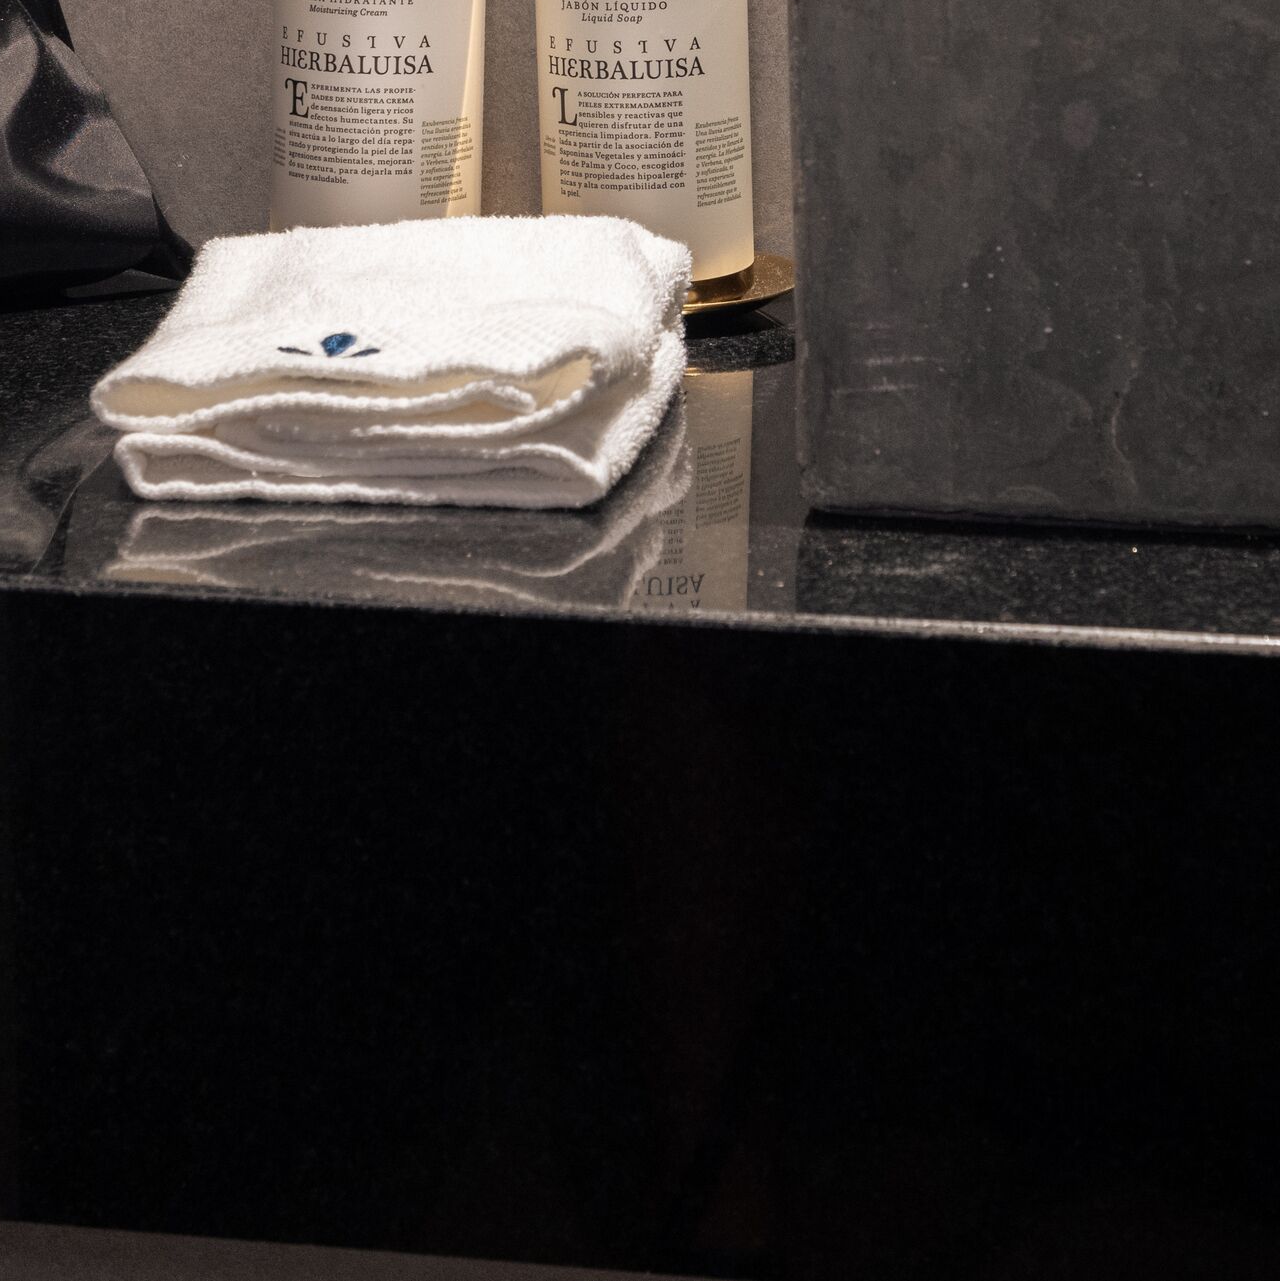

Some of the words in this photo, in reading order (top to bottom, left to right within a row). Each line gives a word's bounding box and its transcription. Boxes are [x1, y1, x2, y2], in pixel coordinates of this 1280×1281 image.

[309, 5, 358, 17] Moisturizing
[360, 8, 388, 17] Cream
[562, 0, 599, 10] JABÓN
[606, 1, 668, 12] LÍQUIDO
[581, 13, 613, 23] Liquid
[617, 14, 643, 23] Soap
[281, 45, 434, 75] HIERBALUISA
[549, 55, 705, 80] HIERBALUISA
[320, 105, 359, 113] sensación
[361, 107, 384, 115] ligera
[605, 101, 683, 109] EXTREMADAMENTE
[310, 113, 338, 122] efectos
[340, 116, 400, 124] humectantes.
[579, 111, 614, 119] sensibles
[625, 111, 665, 119] reactivas
[325, 125, 380, 134] humectación
[579, 121, 609, 129] quieren
[611, 121, 651, 129] disfrutar
[559, 129, 598, 138] experiencia
[600, 132, 651, 140] limpiadora.
[338, 136, 359, 145] largo
[579, 140, 601, 148] partir
[603, 141, 613, 149] de
[313, 145, 359, 155] protegiendo
[371, 148, 387, 156] piel
[560, 148, 593, 158] Saponinas
[595, 152, 635, 160] Vegetales
[323, 155, 375, 165] ambientales,
[581, 160, 605, 169] Palma
[642, 161, 684, 170] escogidos
[306, 163, 336, 173] textura,
[339, 168, 358, 176] para
[361, 168, 392, 176] dejarla
[311, 174, 349, 184] saludable.
[584, 171, 635, 180] propiedades
[584, 181, 598, 189] alta
[601, 181, 667, 191] compatibilidad
